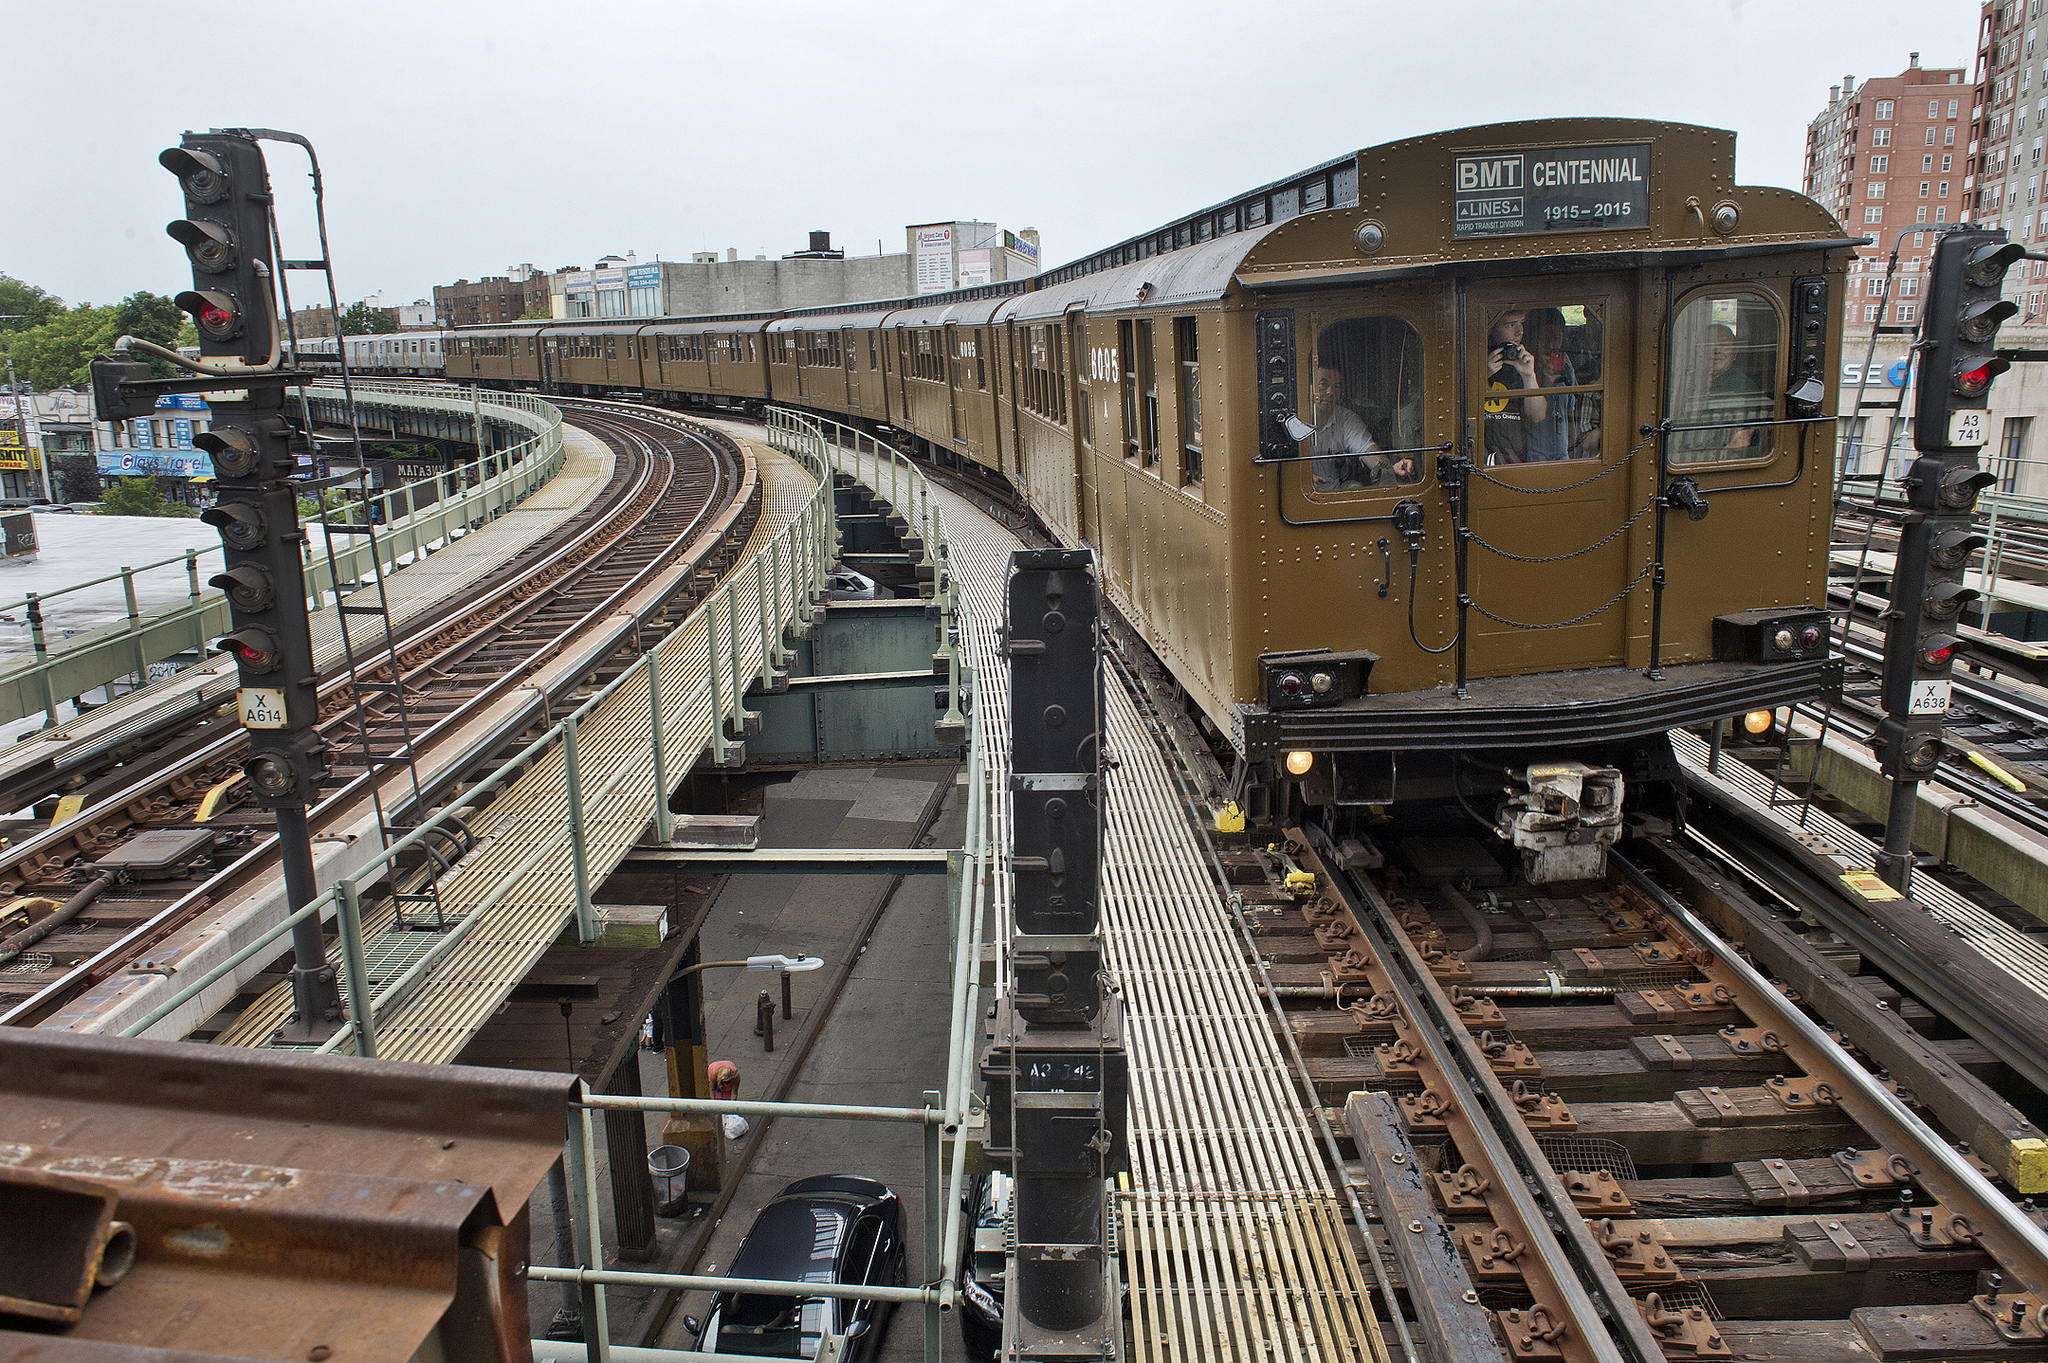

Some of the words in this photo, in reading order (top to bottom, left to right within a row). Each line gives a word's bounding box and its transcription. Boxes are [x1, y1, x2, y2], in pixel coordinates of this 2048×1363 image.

[1460, 160, 1520, 189] BMT
[1532, 157, 1642, 187] CENTENNIAL
[1470, 201, 1511, 216] LINES
[1457, 223, 1474, 231] RAPID
[1475, 221, 1498, 230] TRANSIT
[1499, 219, 1524, 229] DIVISION
[1091, 347, 1118, 384] 6095
[1962, 415, 1979, 426] A3
[1958, 429, 1980, 441] 741
[1926, 686, 1936, 697] X
[255, 694, 267, 707] X
[1913, 697, 1946, 709] A638
[246, 709, 282, 722] A614
